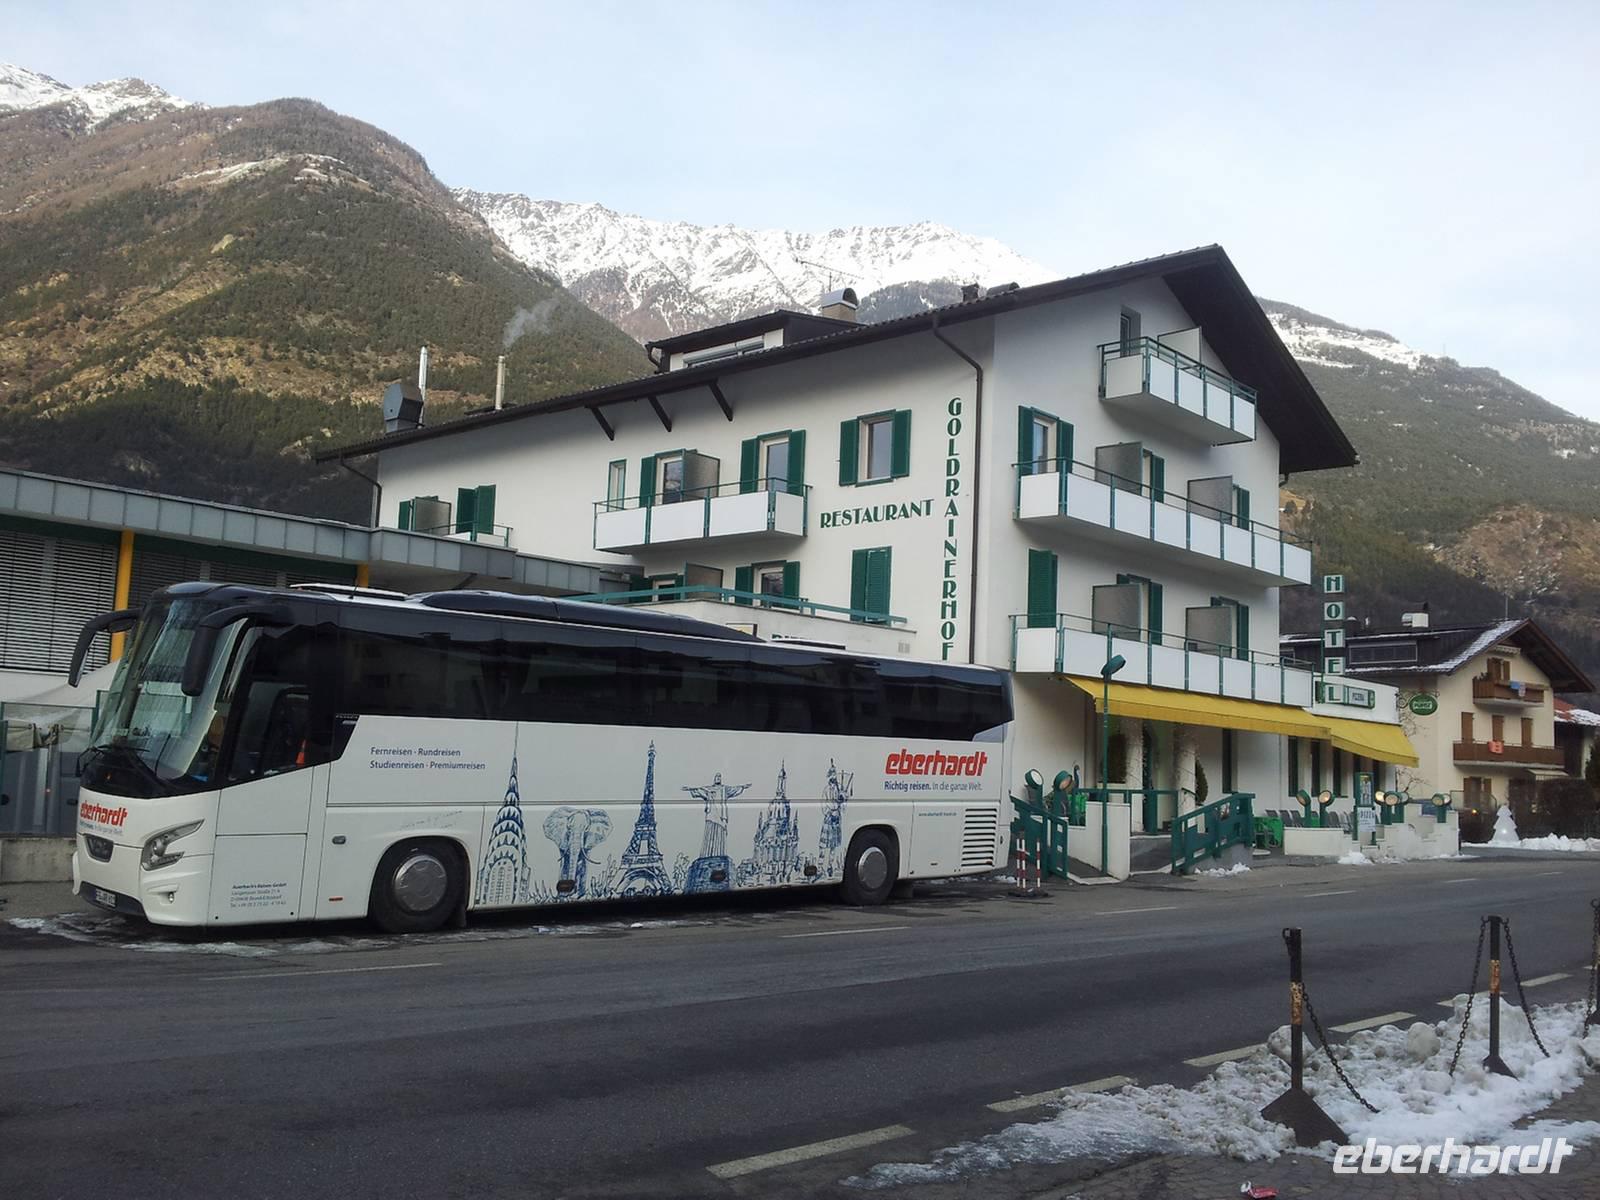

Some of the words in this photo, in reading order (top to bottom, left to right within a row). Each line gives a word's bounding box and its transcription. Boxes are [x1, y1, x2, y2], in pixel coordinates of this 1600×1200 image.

[820, 499, 934, 528] RESTAURANT
[940, 397, 962, 661] GOLDRAINERHOF
[1325, 575, 1342, 703] HOTEL
[370, 746, 412, 756] Fernreisen
[417, 747, 461, 757] Rundreisen
[370, 759, 424, 769] Studienreisen
[429, 761, 486, 770] Premiumreisen
[885, 748, 988, 776] eberhardt
[884, 780, 908, 792] Richtig
[909, 781, 931, 790] reisen.
[940, 781, 949, 790] die
[950, 783, 968, 792] ganze
